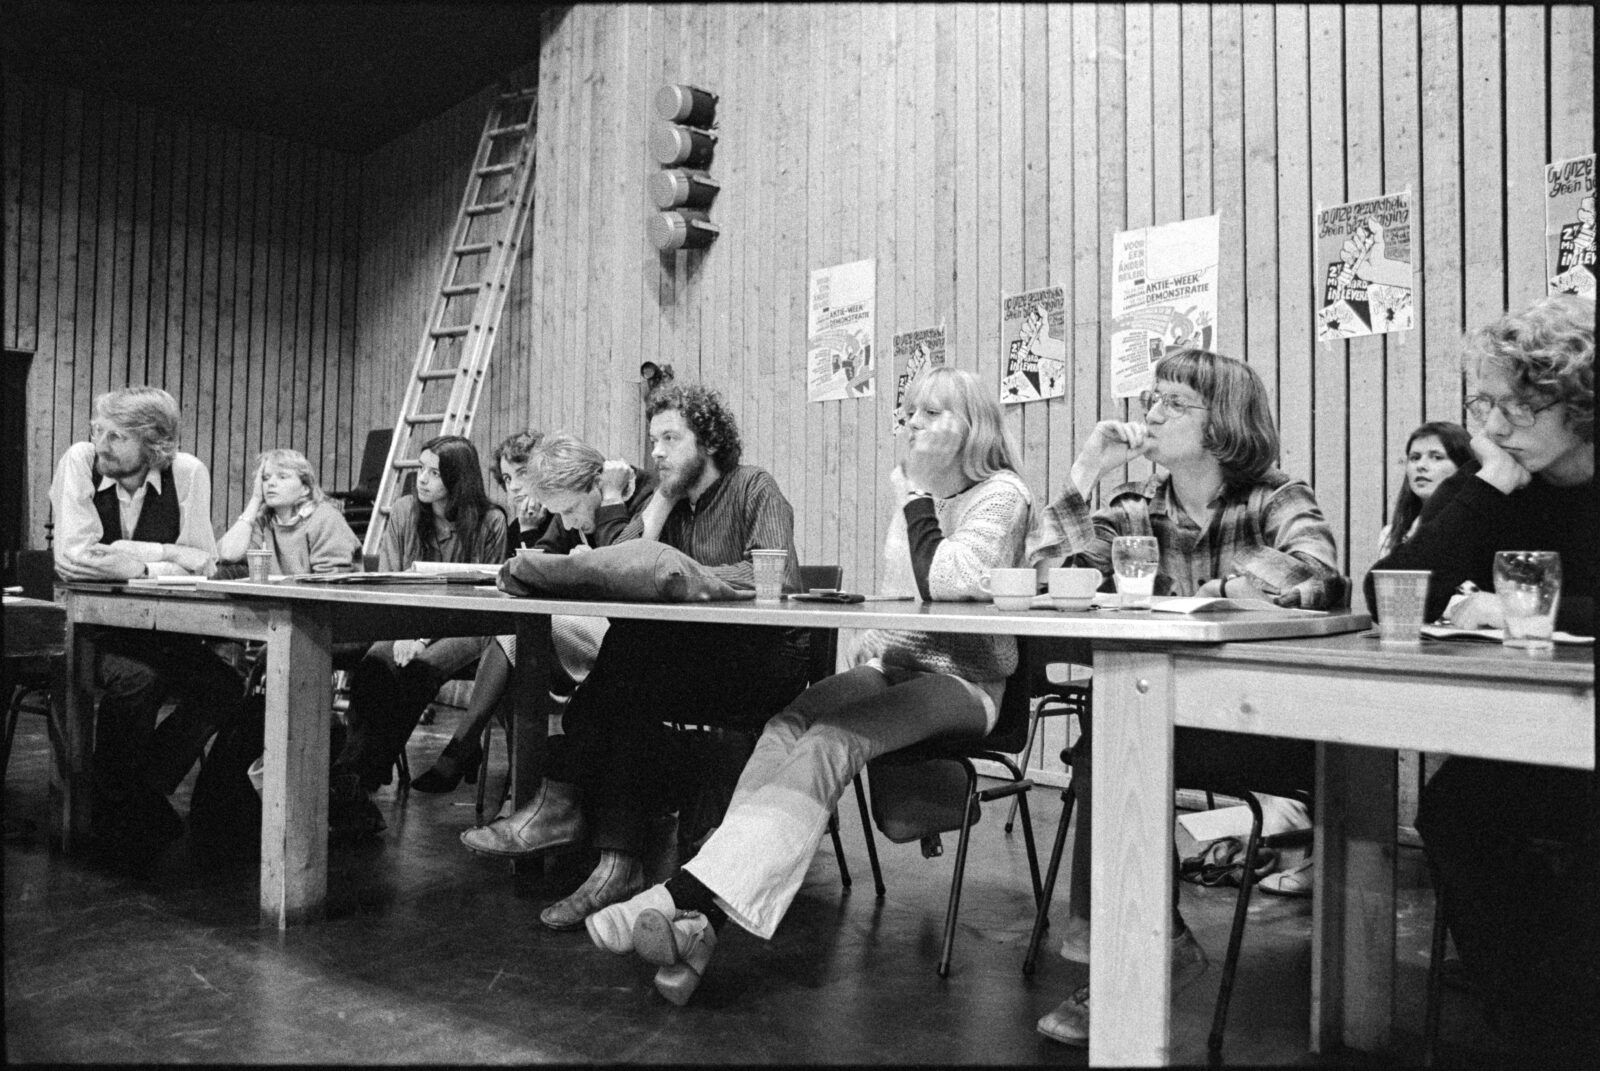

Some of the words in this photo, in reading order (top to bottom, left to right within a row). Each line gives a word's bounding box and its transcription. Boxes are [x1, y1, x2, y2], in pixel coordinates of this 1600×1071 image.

[1564, 158, 1593, 181] onze
[1330, 205, 1352, 224] onze
[1346, 209, 1409, 235] bezuniging
[1128, 249, 1145, 260] EEN
[1146, 273, 1200, 294] AKTIE-WEEK
[1146, 282, 1209, 304] DEMONSTRATIE
